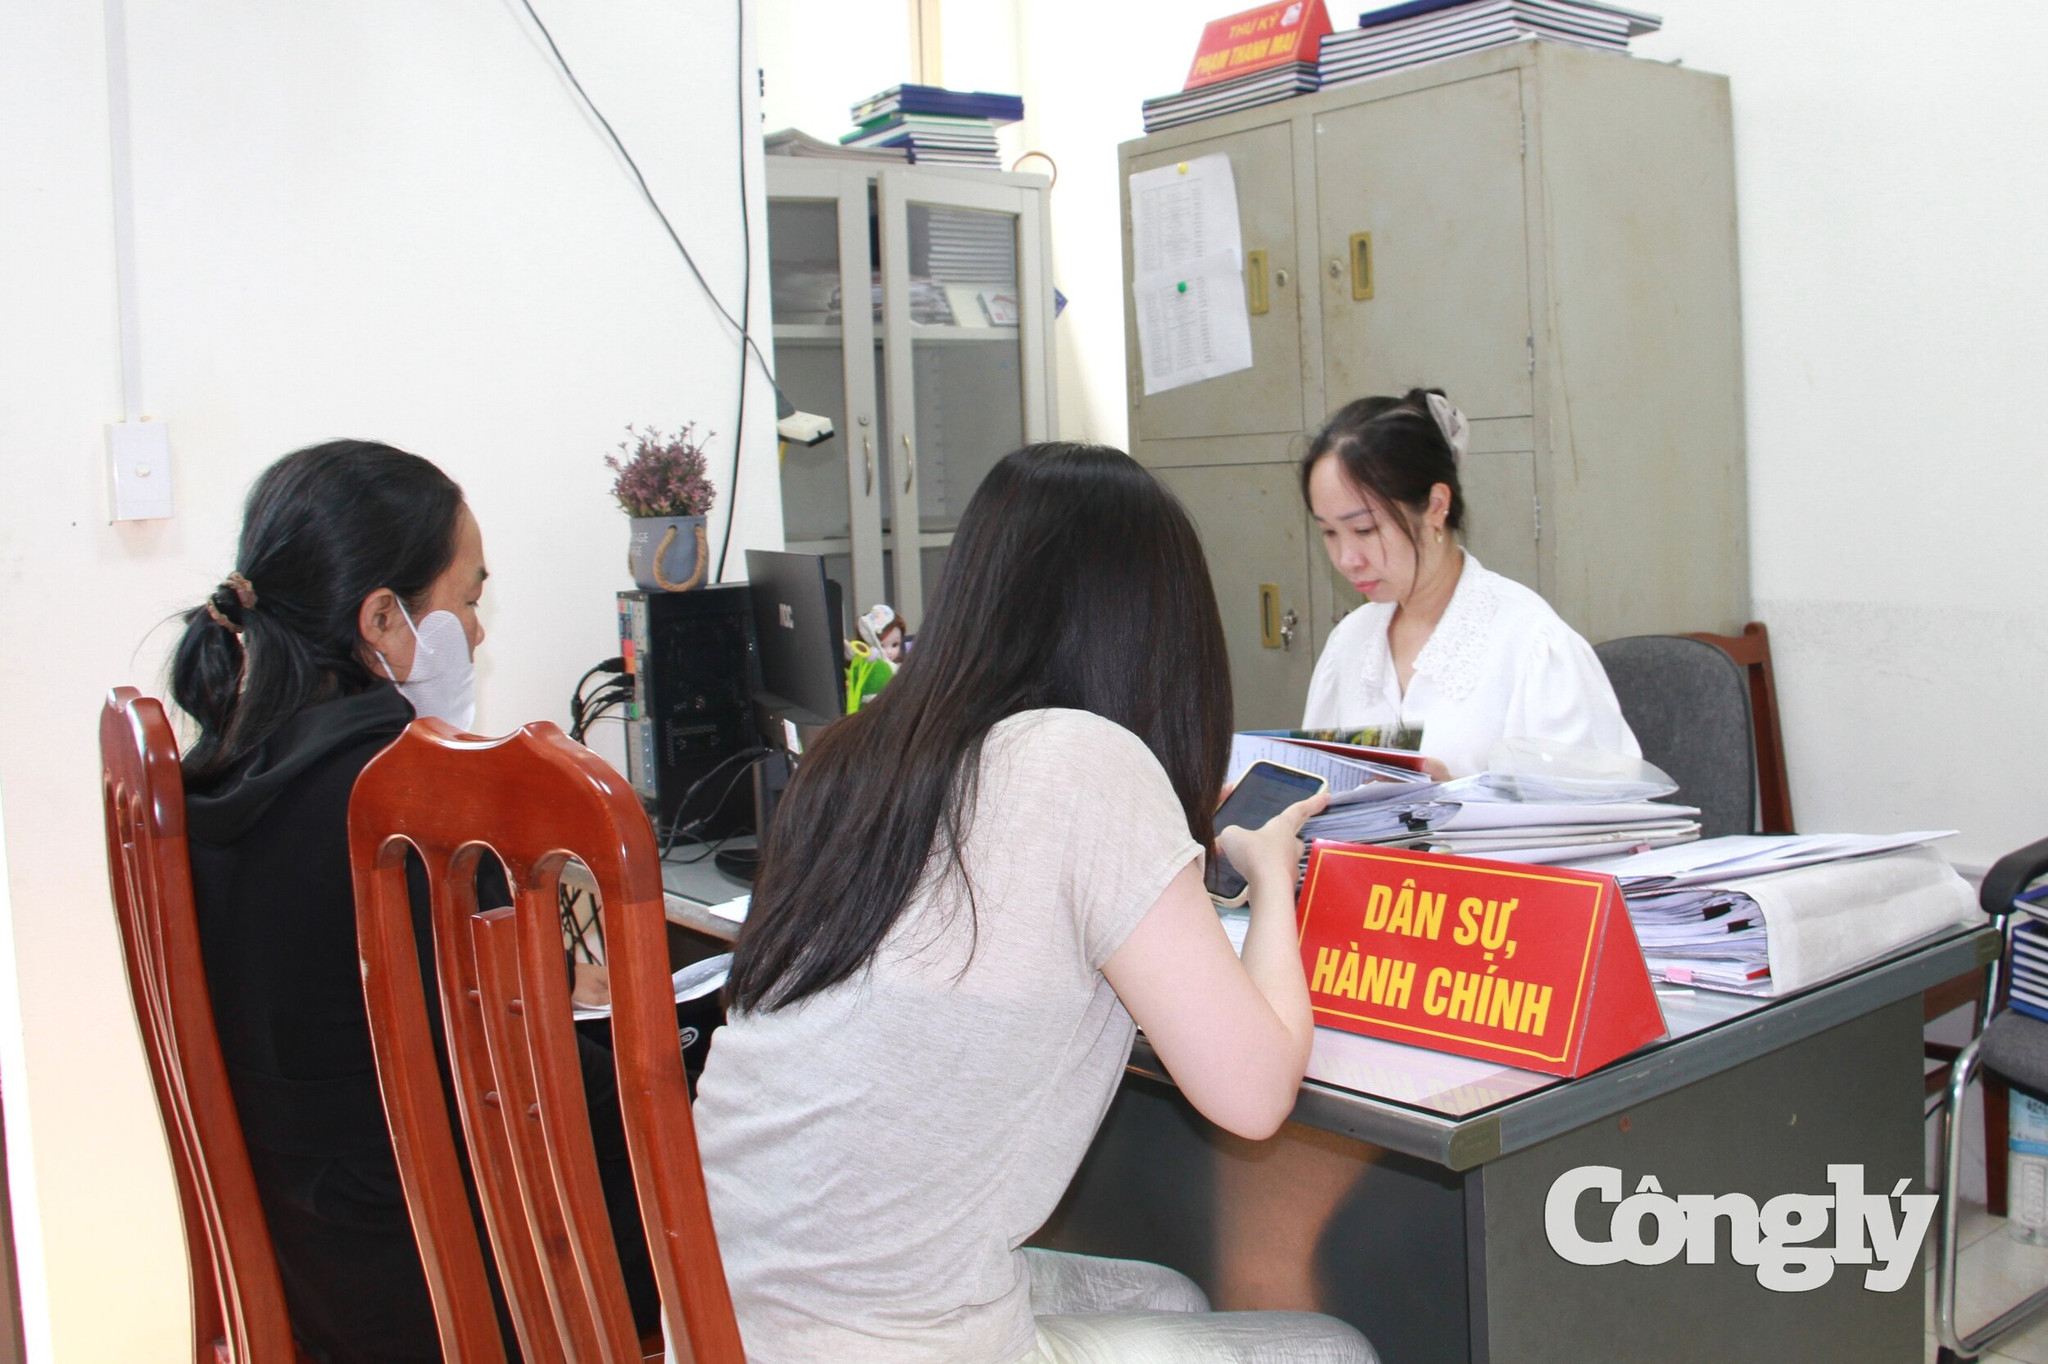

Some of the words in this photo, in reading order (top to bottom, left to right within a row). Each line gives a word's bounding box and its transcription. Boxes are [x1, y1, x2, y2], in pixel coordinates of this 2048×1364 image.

[1363, 878, 1448, 940] DÂN
[1453, 897, 1519, 960] SỰ,
[1310, 941, 1417, 1010] HÀNH
[1423, 965, 1553, 1036] CHÍNH
